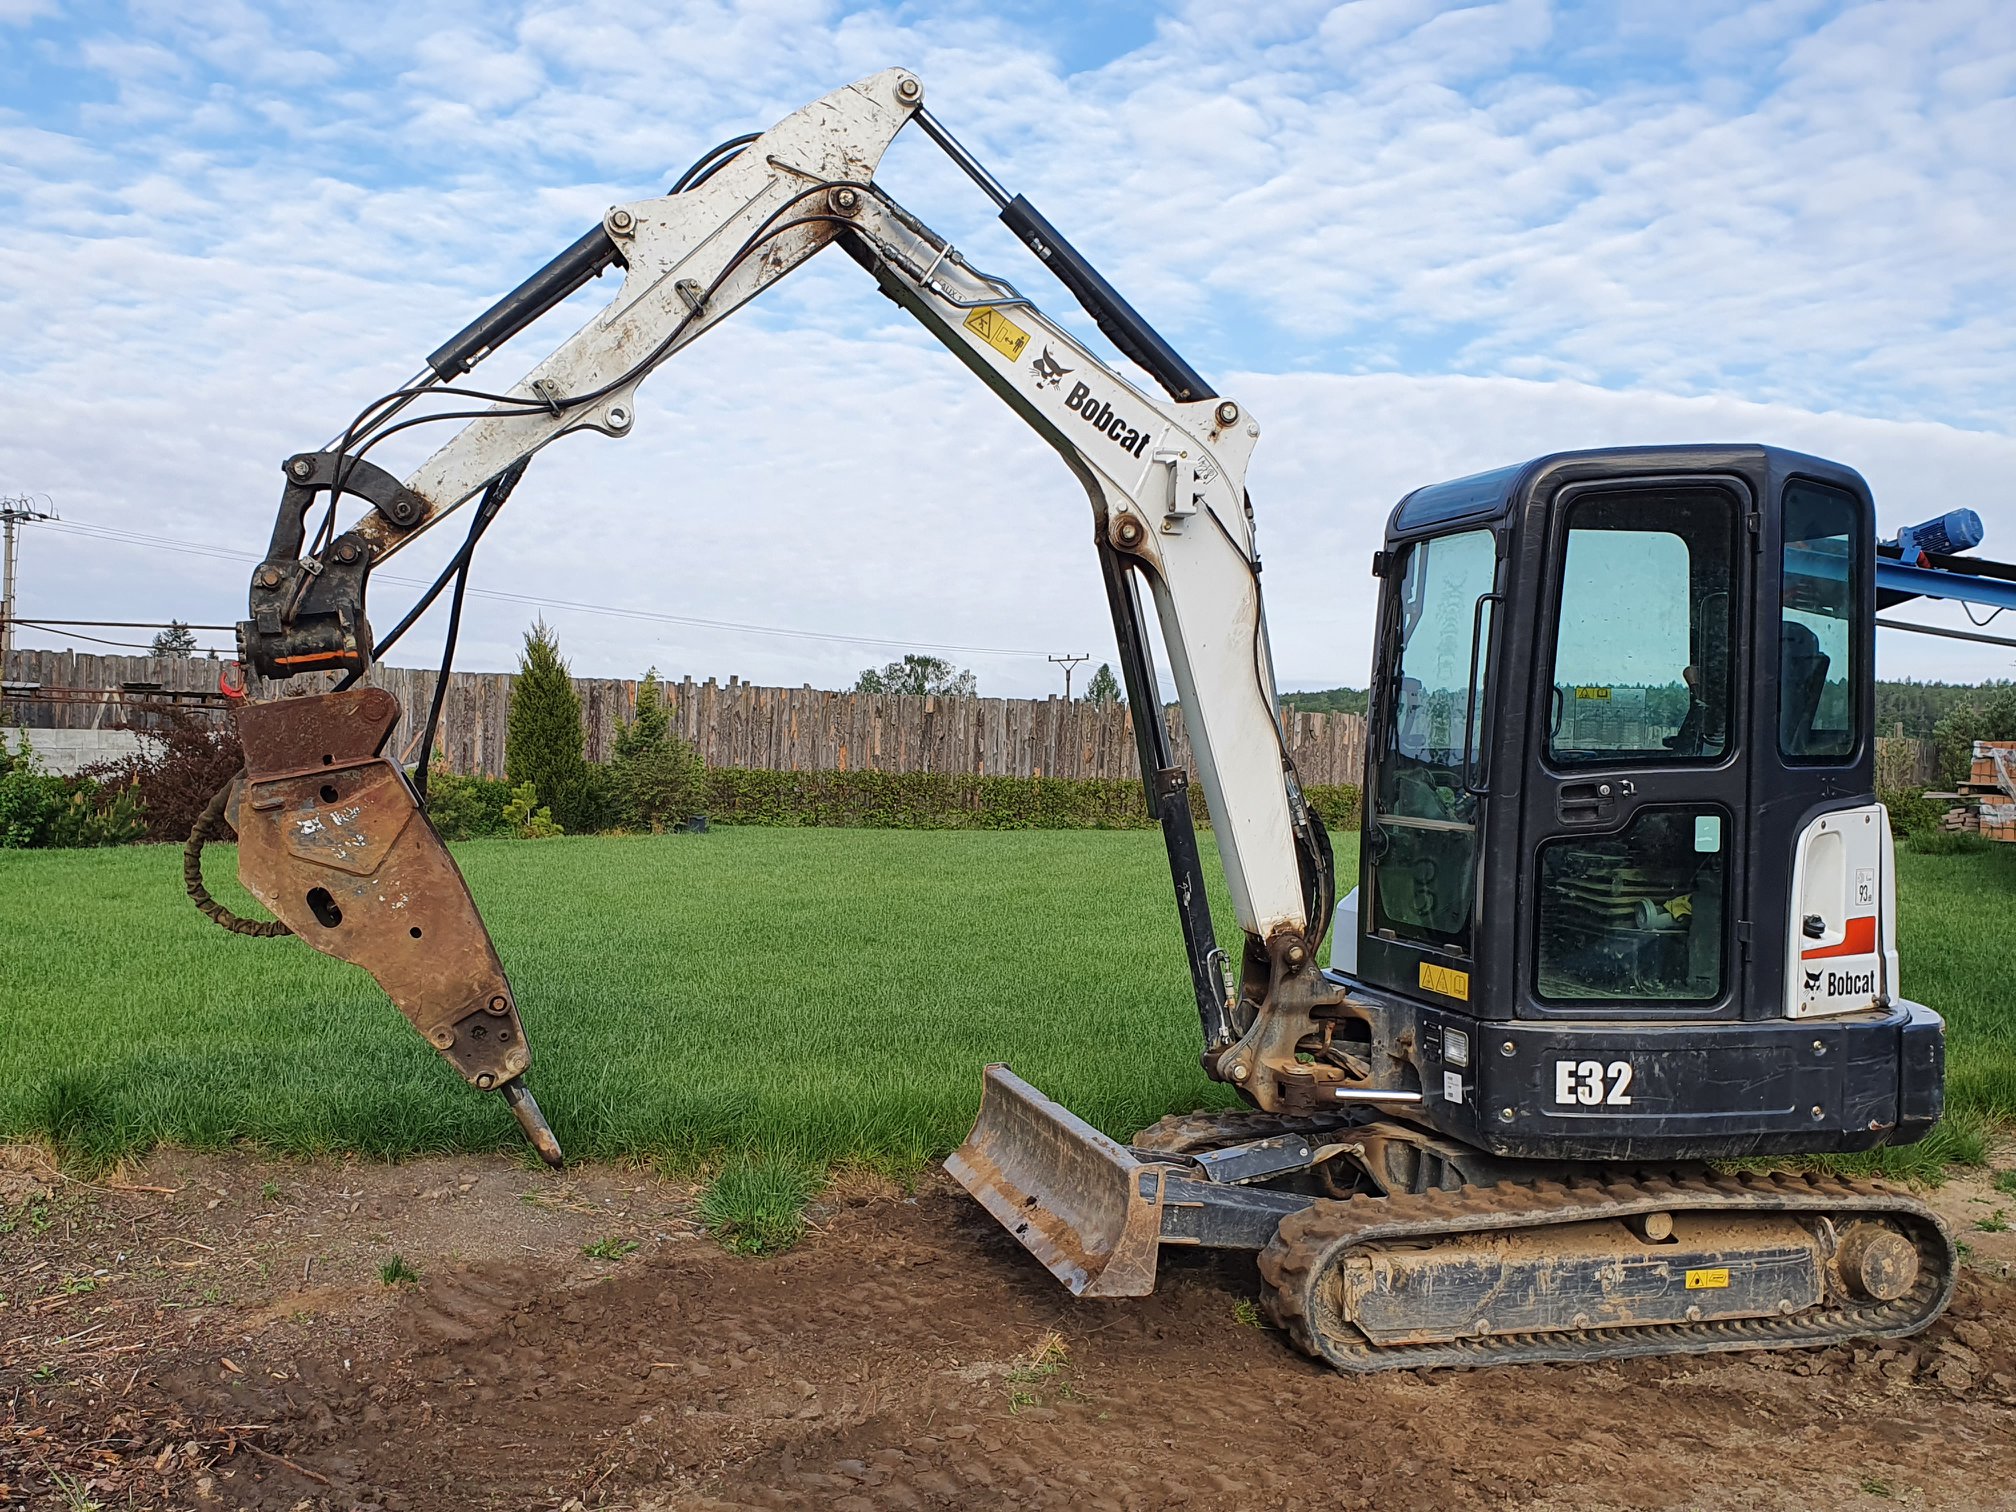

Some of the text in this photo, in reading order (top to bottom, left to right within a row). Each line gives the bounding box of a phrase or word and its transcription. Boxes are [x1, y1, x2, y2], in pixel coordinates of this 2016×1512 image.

[1064, 380, 1152, 460] Bobcat
[1859, 884, 1868, 902] 93
[1827, 970, 1875, 997] Bobcat
[1555, 1060, 1633, 1106] E32
